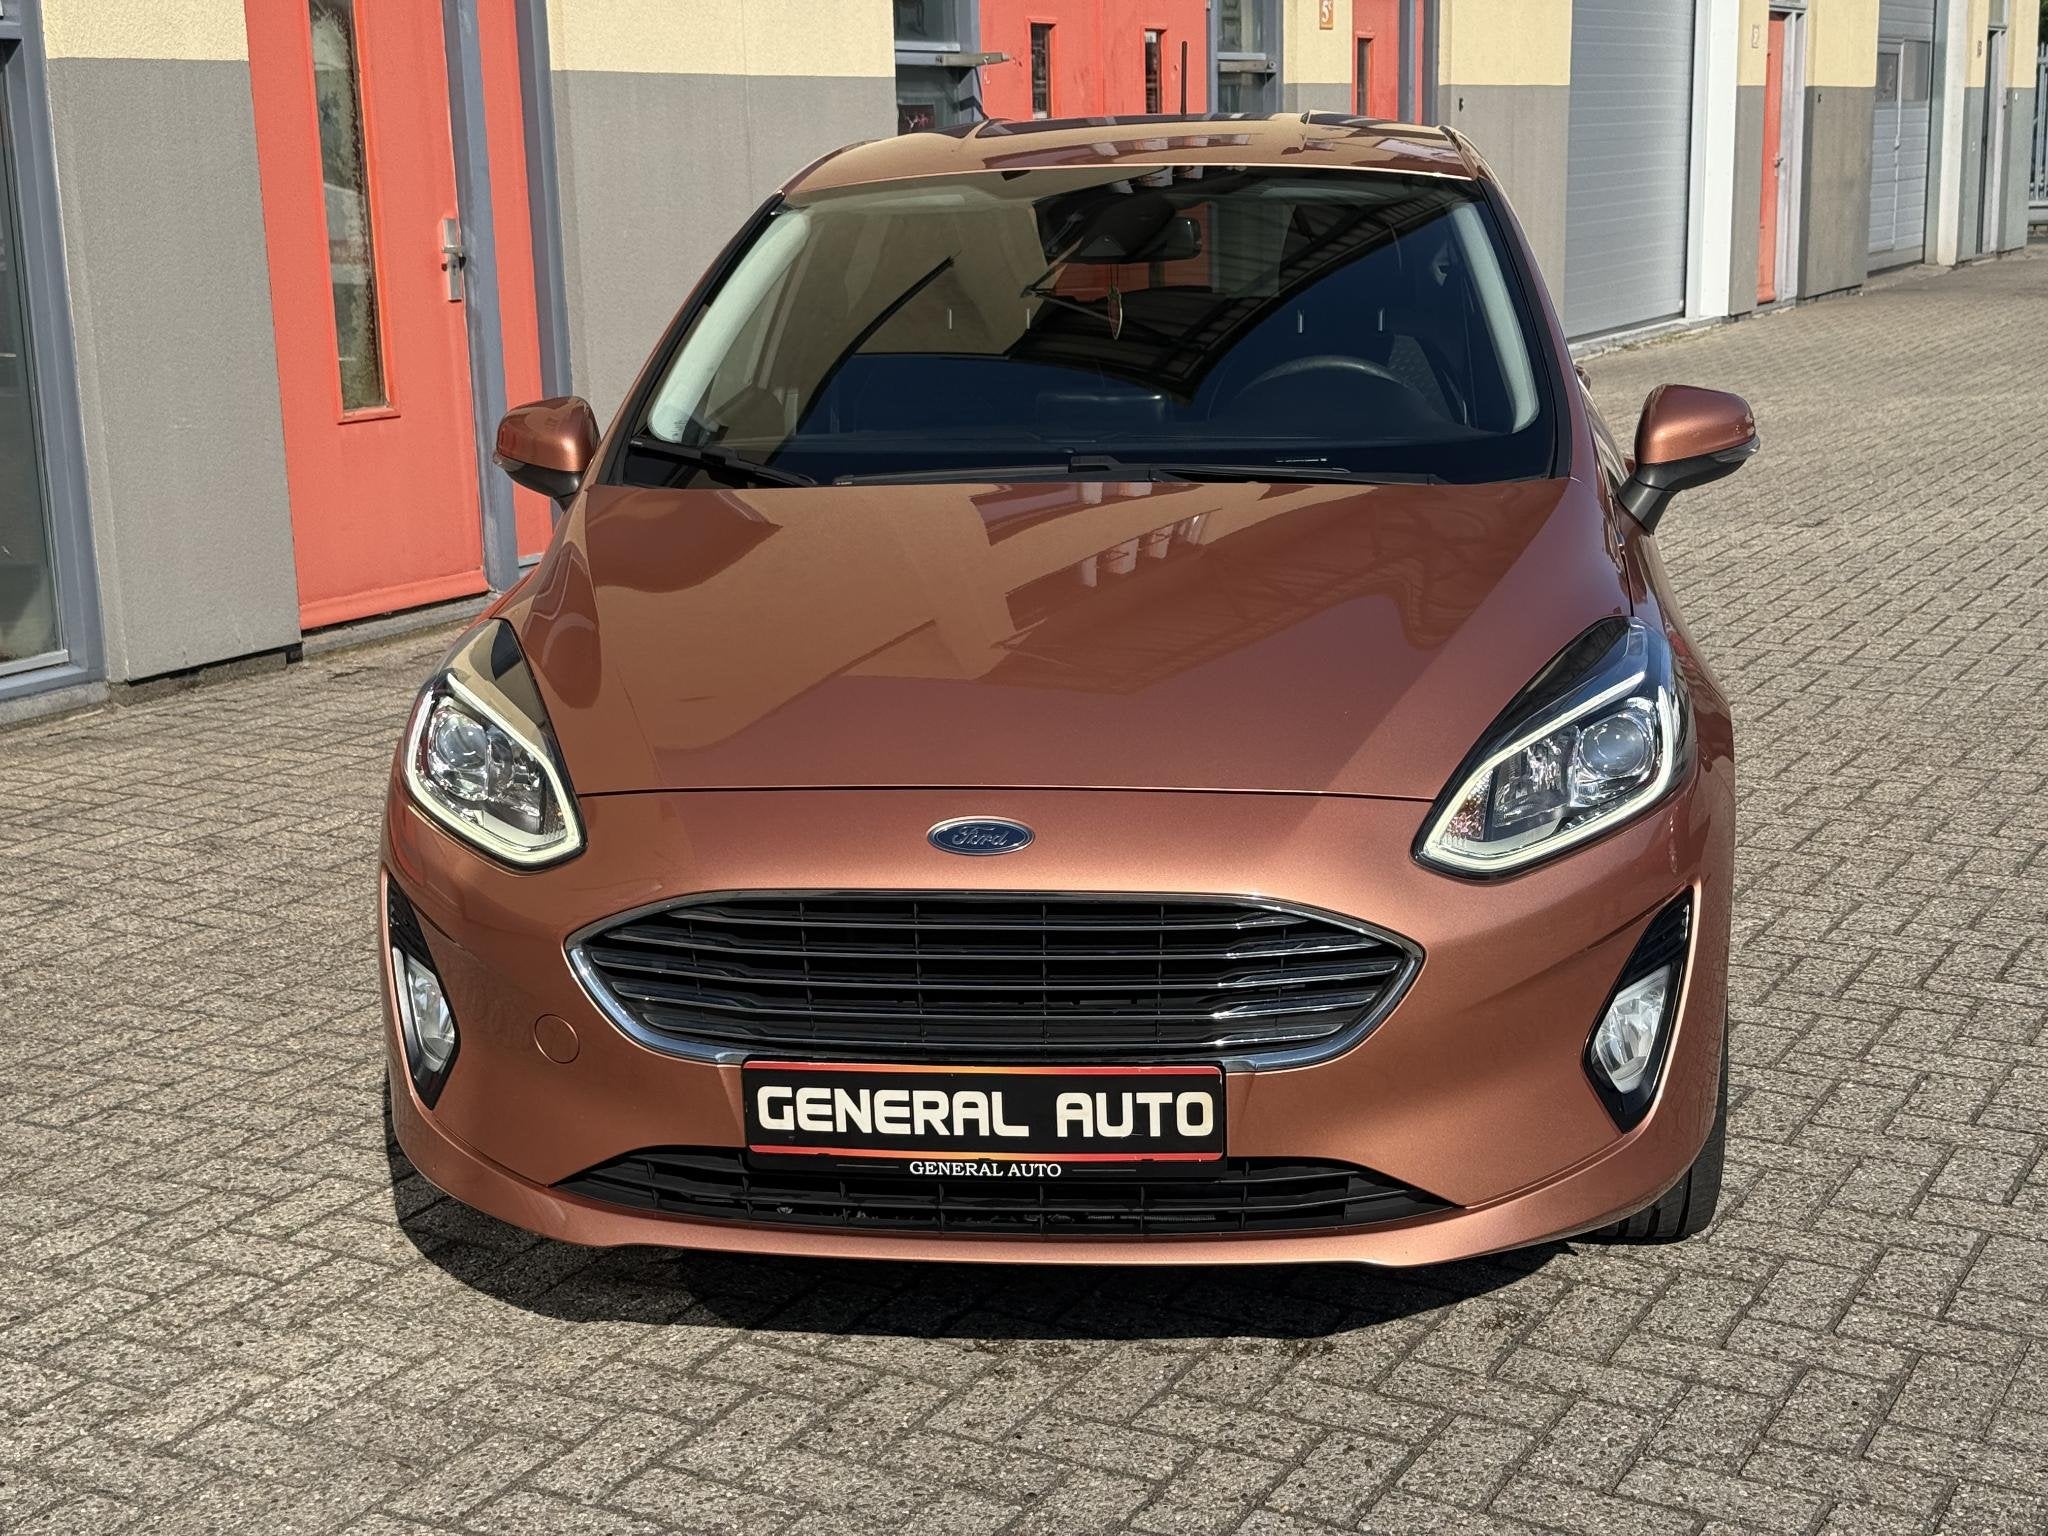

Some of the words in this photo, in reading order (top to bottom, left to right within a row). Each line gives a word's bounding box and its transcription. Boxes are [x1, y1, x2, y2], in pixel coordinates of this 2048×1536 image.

[951, 826, 1010, 846] Ford
[757, 1085, 1030, 1138] GENERAL
[1056, 1091, 1214, 1138] AUTO
[909, 1161, 1004, 1177] GENERAL
[1007, 1163, 1062, 1178] AUTO
